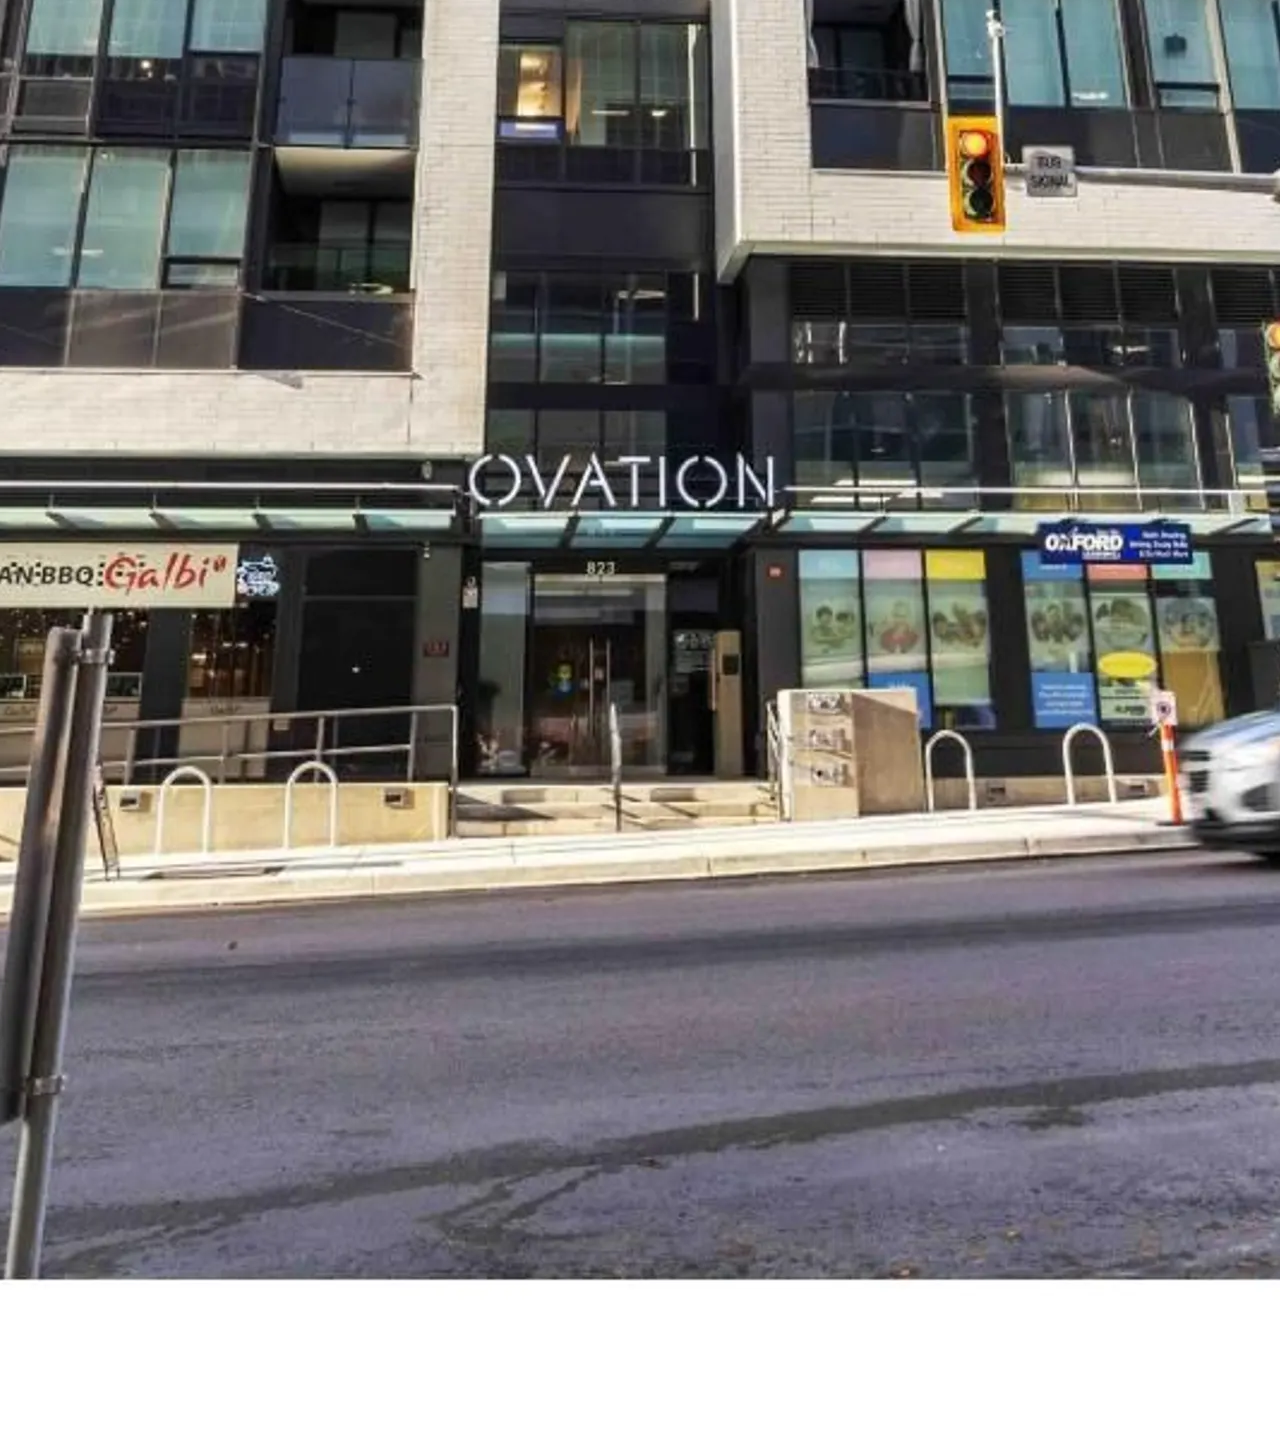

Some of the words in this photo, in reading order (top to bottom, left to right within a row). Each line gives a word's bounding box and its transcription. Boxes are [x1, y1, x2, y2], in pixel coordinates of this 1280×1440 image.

[469, 452, 775, 508] OVATION
[1045, 530, 1124, 552] OXFORD
[40, 565, 95, 587] BBQ
[104, 552, 209, 596] Galbi
